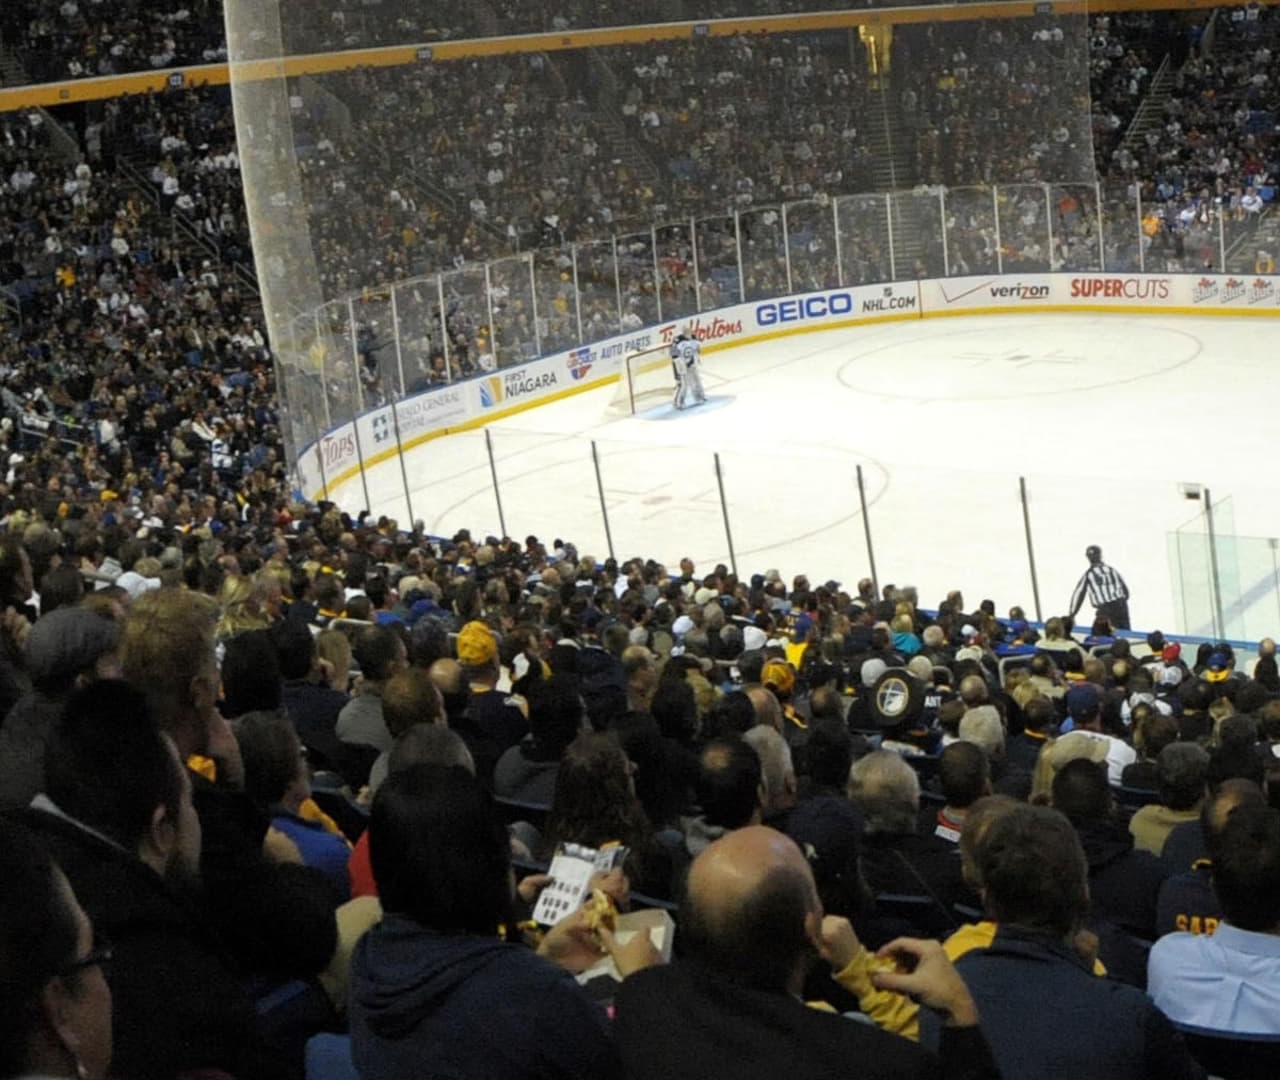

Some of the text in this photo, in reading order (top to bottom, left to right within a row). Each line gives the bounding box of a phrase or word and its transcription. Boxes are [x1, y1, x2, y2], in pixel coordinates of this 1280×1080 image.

[990, 278, 1050, 299] verizon
[1070, 278, 1168, 299] SUPERCUTS
[755, 292, 853, 326] GEICO
[862, 294, 917, 313] NHL.COM
[689, 318, 743, 342] Hortons
[600, 335, 651, 360] AUTO PARTS
[505, 370, 526, 383] FIRST
[505, 372, 558, 397] NIAGARA
